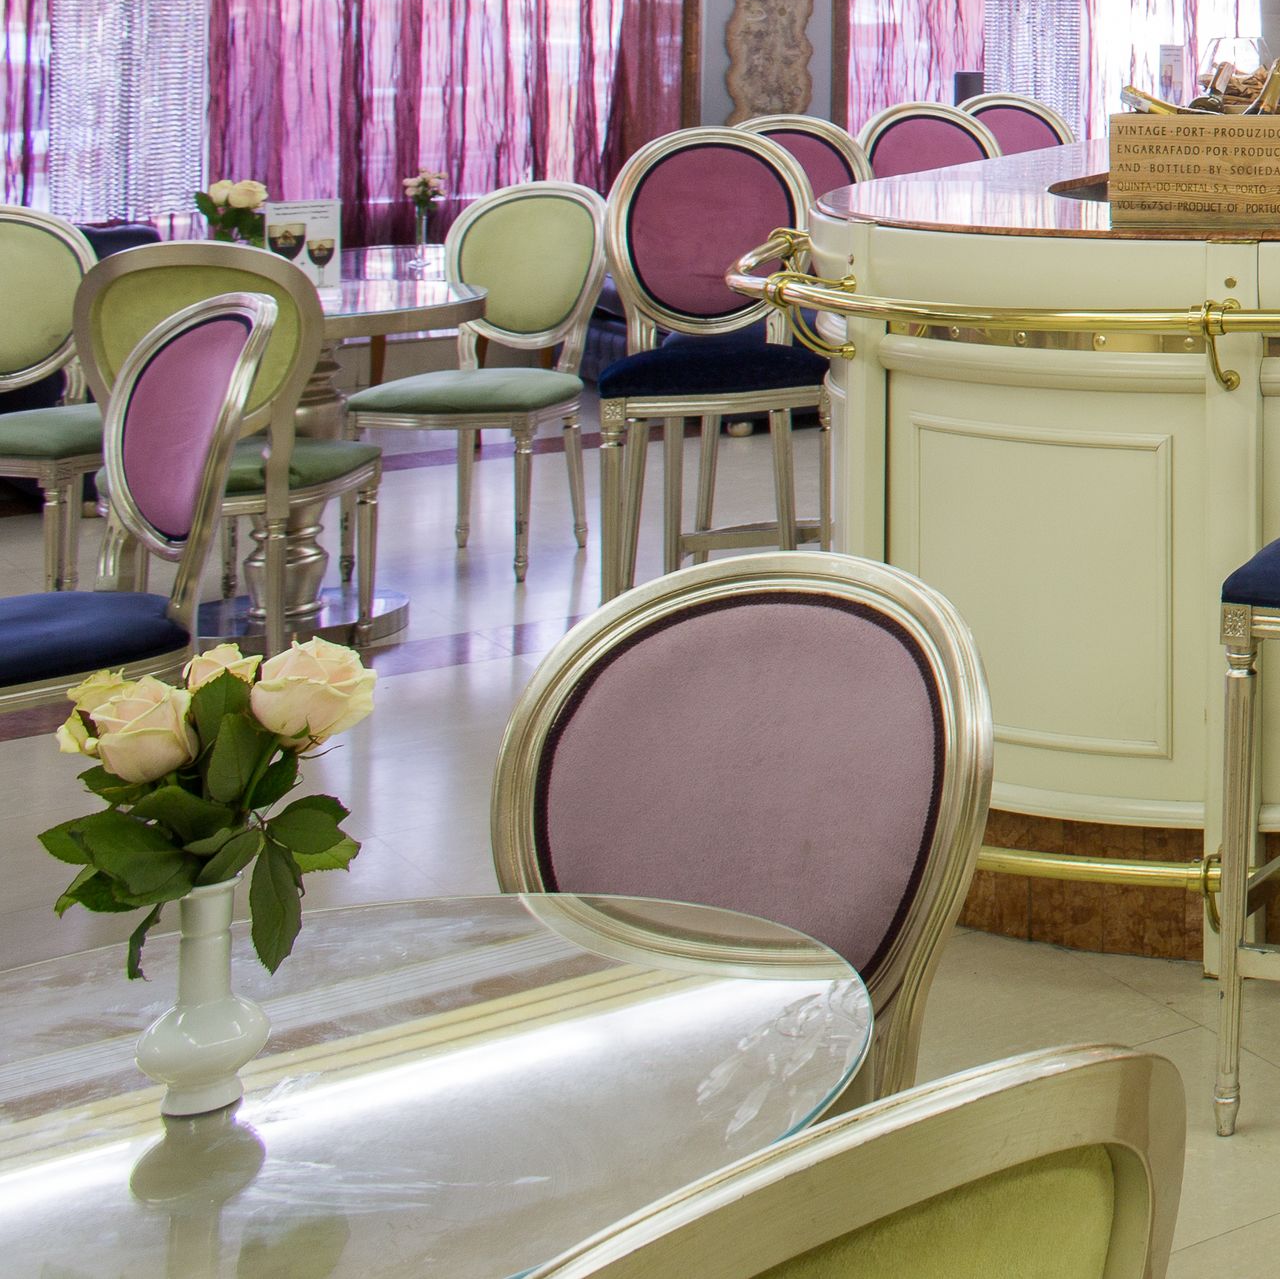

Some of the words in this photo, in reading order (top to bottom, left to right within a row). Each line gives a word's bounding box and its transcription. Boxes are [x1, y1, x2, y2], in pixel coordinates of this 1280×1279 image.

[1117, 126, 1167, 136] VINTAGE
[1176, 126, 1205, 137] PORT
[1117, 144, 1200, 156] ENGARRAFADO
[1206, 146, 1233, 156] POR
[1117, 162, 1141, 172] AND
[1150, 163, 1200, 174] BOTTLED
[1209, 165, 1222, 175] BY
[1117, 182, 1151, 192] QUINTA
[1156, 182, 1171, 192] DO
[1175, 182, 1209, 193] PORTAL
[1236, 184, 1267, 194] PORTO
[1117, 200, 1135, 210] VOL
[1178, 202, 1222, 213] PRODUCT
[1226, 203, 1239, 213] OF
